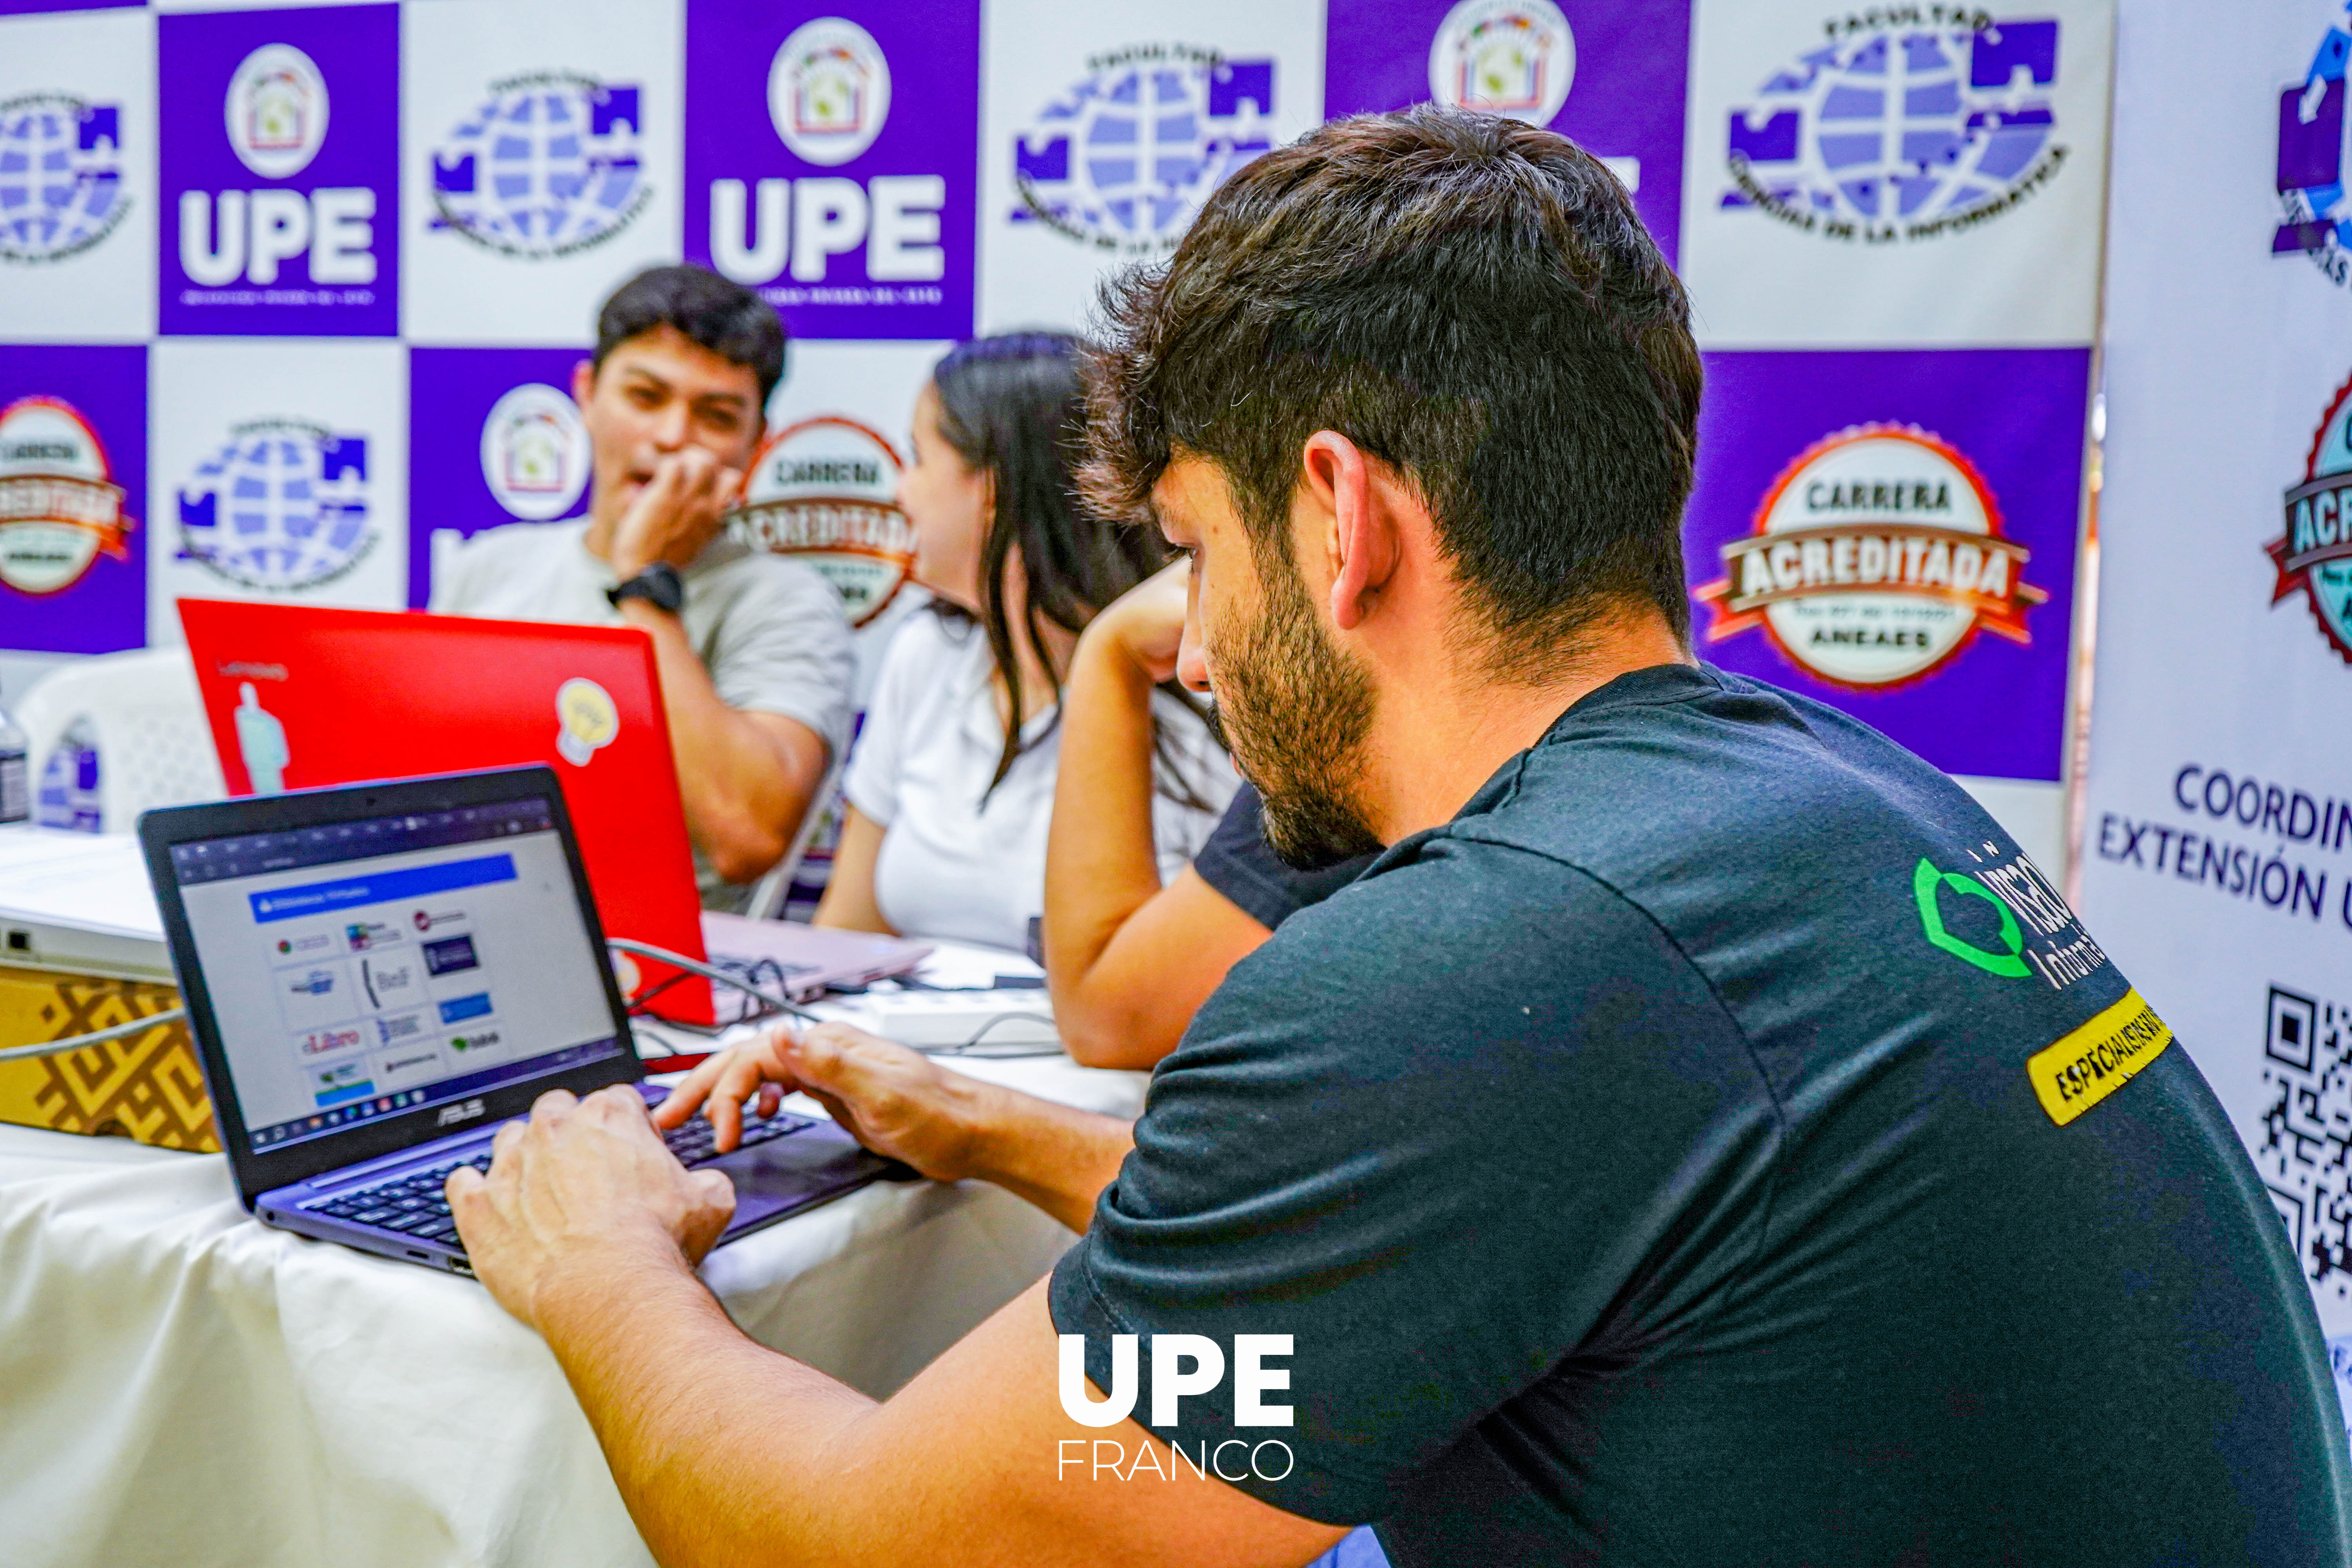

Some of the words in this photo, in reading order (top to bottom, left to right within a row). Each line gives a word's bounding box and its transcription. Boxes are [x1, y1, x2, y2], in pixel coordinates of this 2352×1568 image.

[1825, 5, 1993, 36] FACULTAD
[178, 187, 377, 287] UPE
[709, 174, 946, 285] UPE
[1866, 223, 1898, 244] LA
[1806, 479, 1951, 511] CARRERA
[1740, 536, 2009, 597] ACREDITADA
[2098, 811, 2328, 919] EXTENSIÓN
[437, 1099, 485, 1127] ASUS
